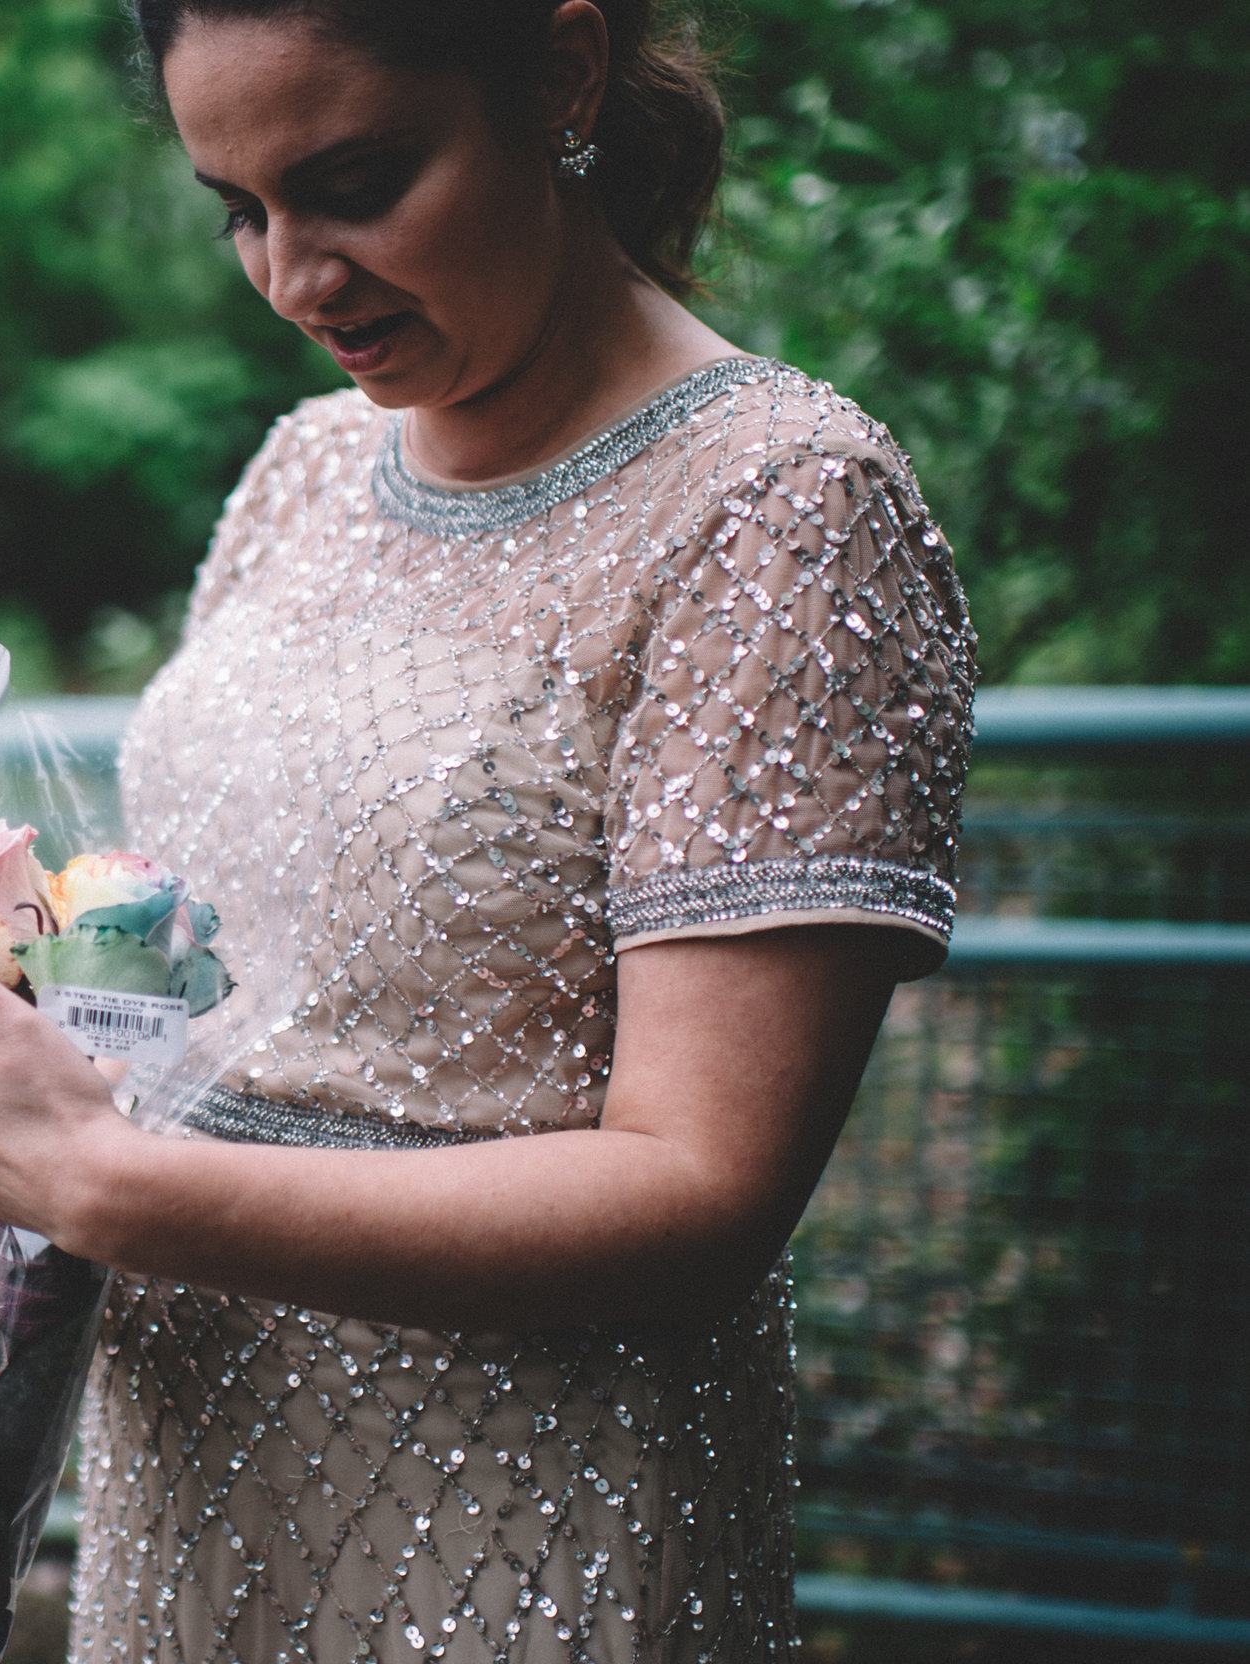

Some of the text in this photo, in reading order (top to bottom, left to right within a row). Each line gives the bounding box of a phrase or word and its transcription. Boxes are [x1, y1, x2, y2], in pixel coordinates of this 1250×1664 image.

[64, 991, 97, 1001] STEM
[101, 996, 119, 1004] TIE
[123, 998, 147, 1008] DYE
[151, 1002, 184, 1011] ROSE
[83, 1001, 144, 1014] RAINBOW
[116, 1028, 151, 1041] 00106
